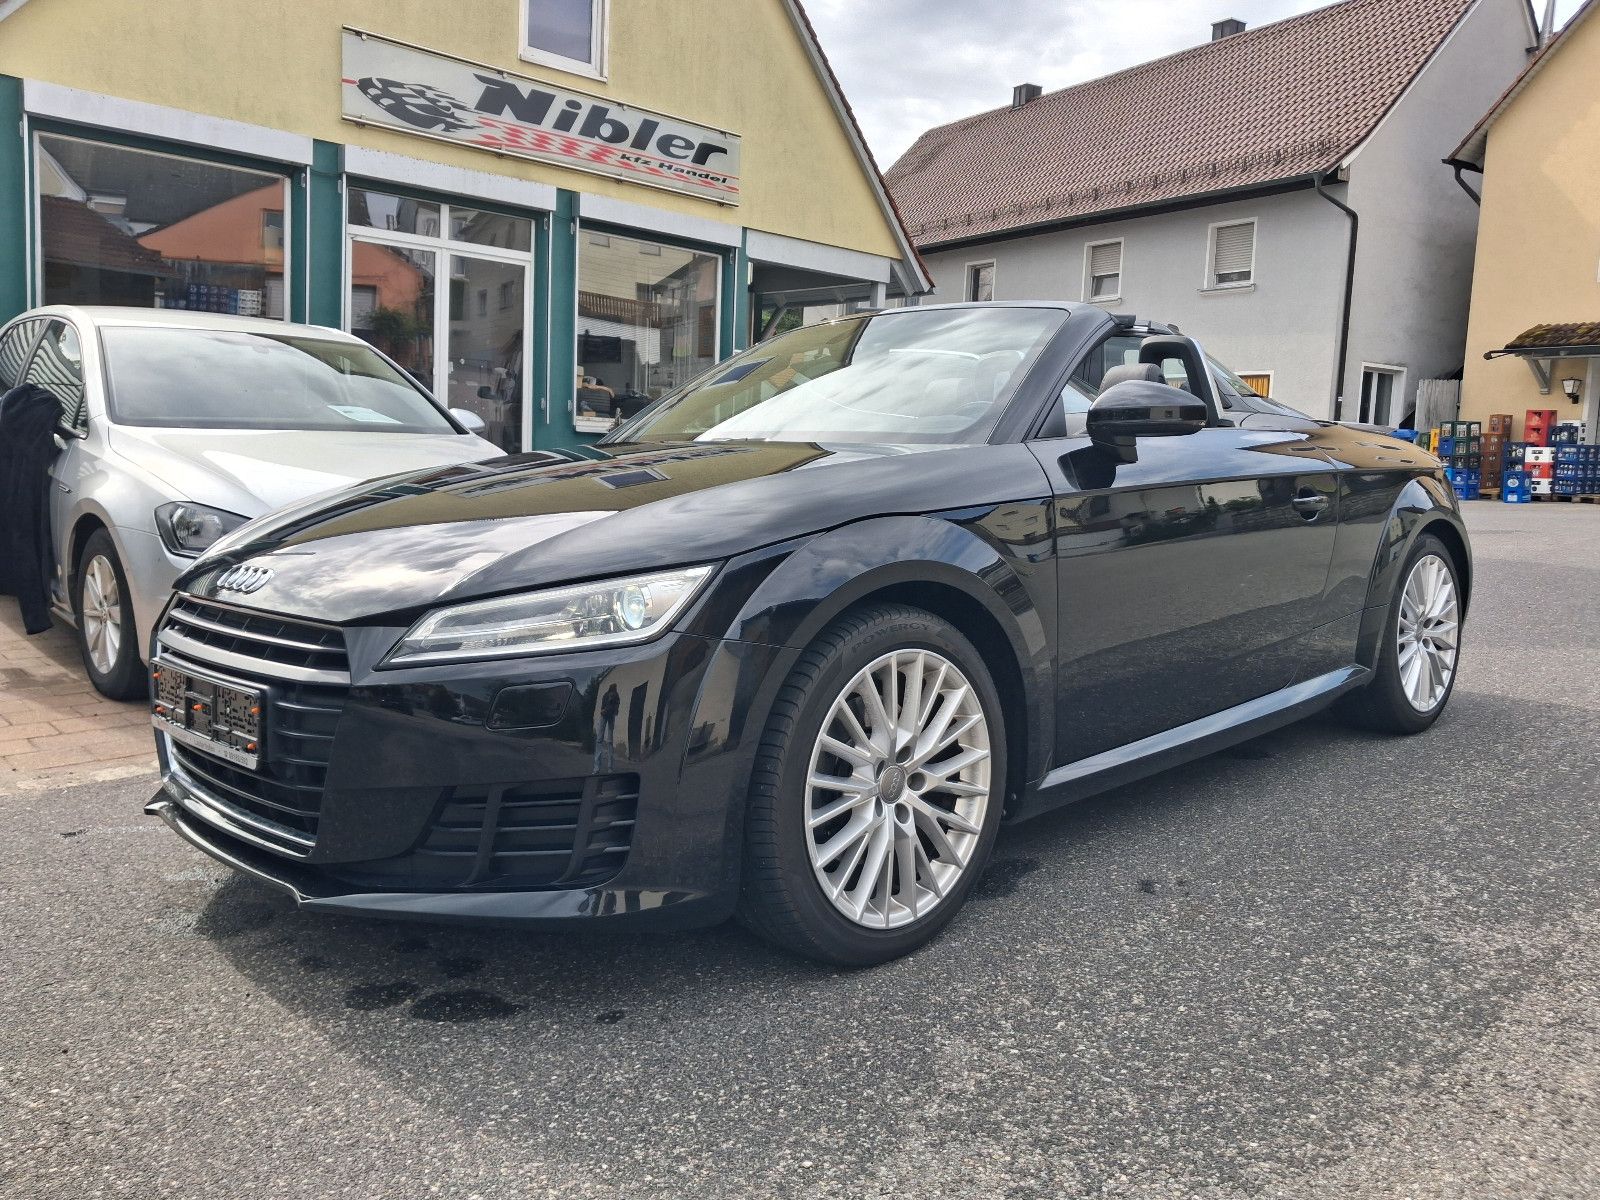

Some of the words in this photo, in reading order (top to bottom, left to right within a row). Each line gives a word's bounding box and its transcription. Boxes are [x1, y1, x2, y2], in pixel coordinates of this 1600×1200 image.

[473, 73, 728, 166] Nibler
[620, 153, 652, 166] kfz
[658, 162, 728, 184] Handel
